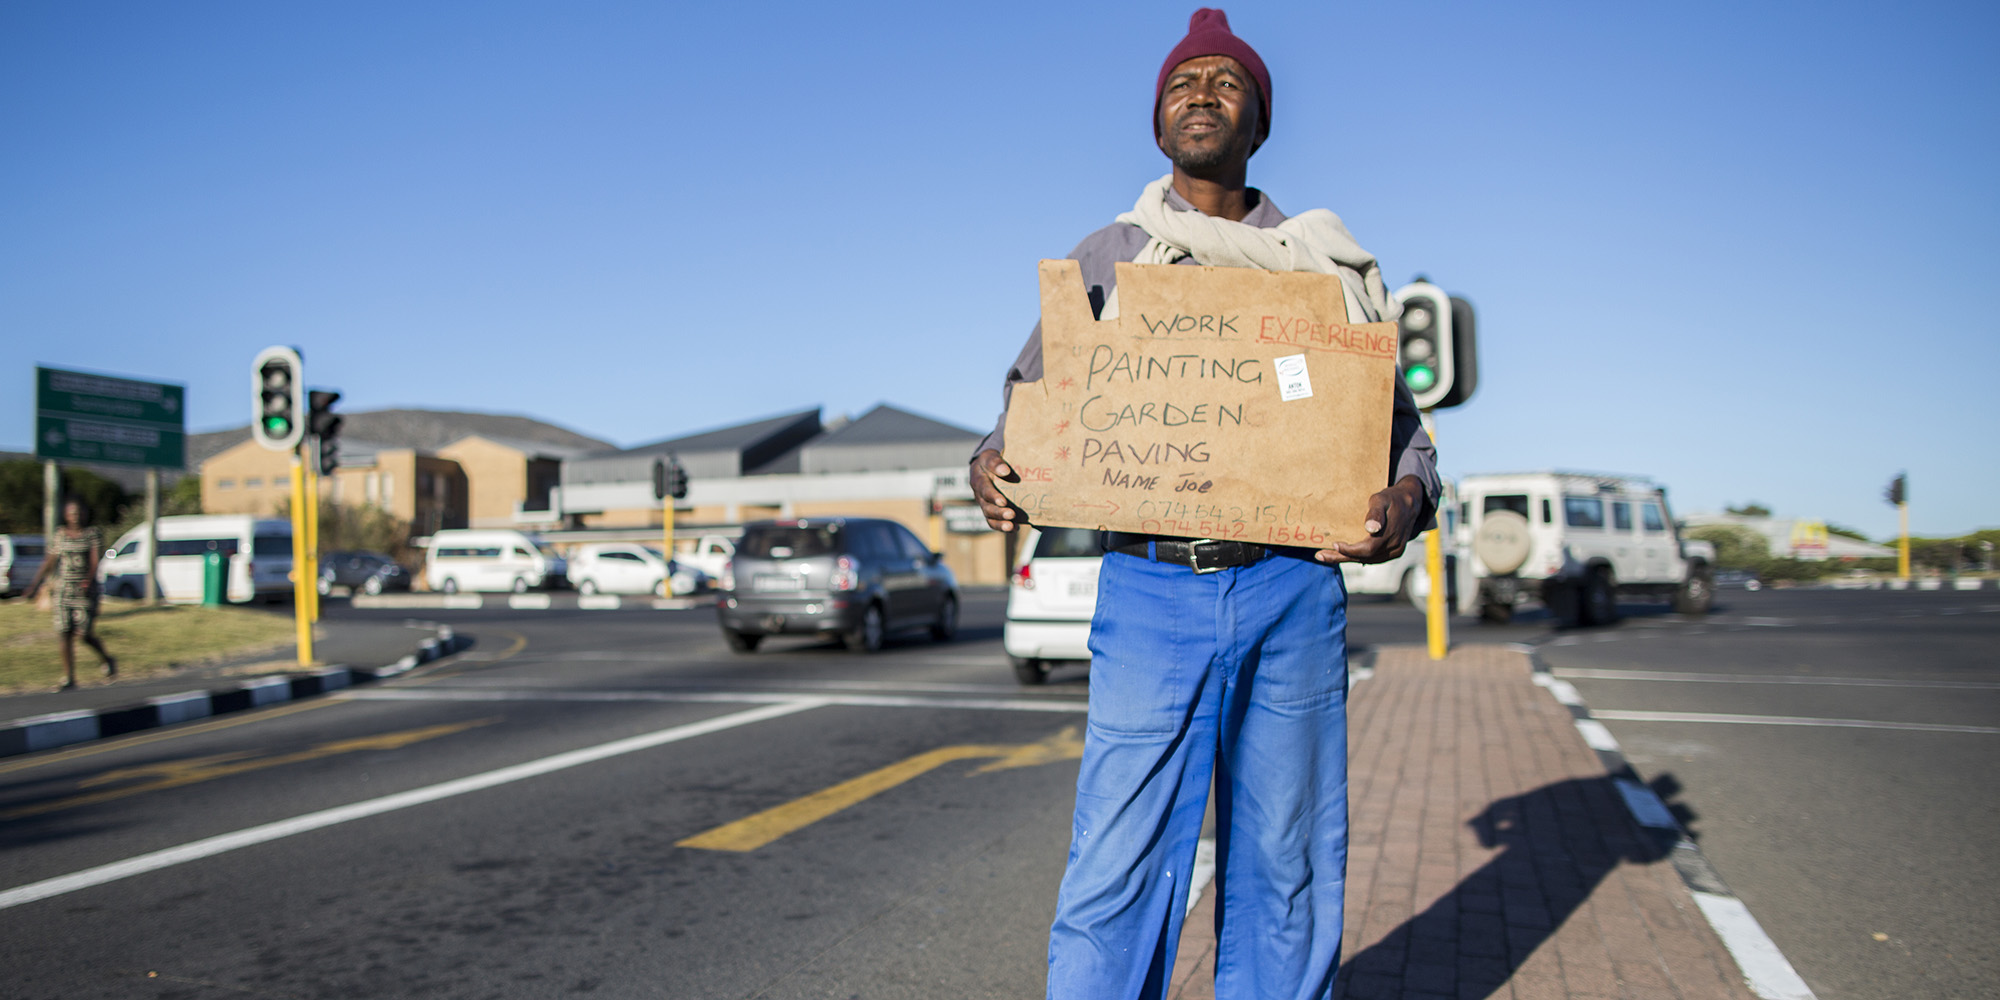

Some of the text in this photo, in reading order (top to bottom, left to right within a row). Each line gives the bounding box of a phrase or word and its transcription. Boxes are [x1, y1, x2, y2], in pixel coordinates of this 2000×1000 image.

[1141, 313, 1398, 353] WORK EXPERIENCE
[1087, 344, 1262, 391] PAINTING
[1081, 438, 1210, 467] PAVING
[1008, 465, 1053, 479] AME
[1102, 467, 1213, 493] NAME Joe
[1267, 525, 1325, 544] 1566
